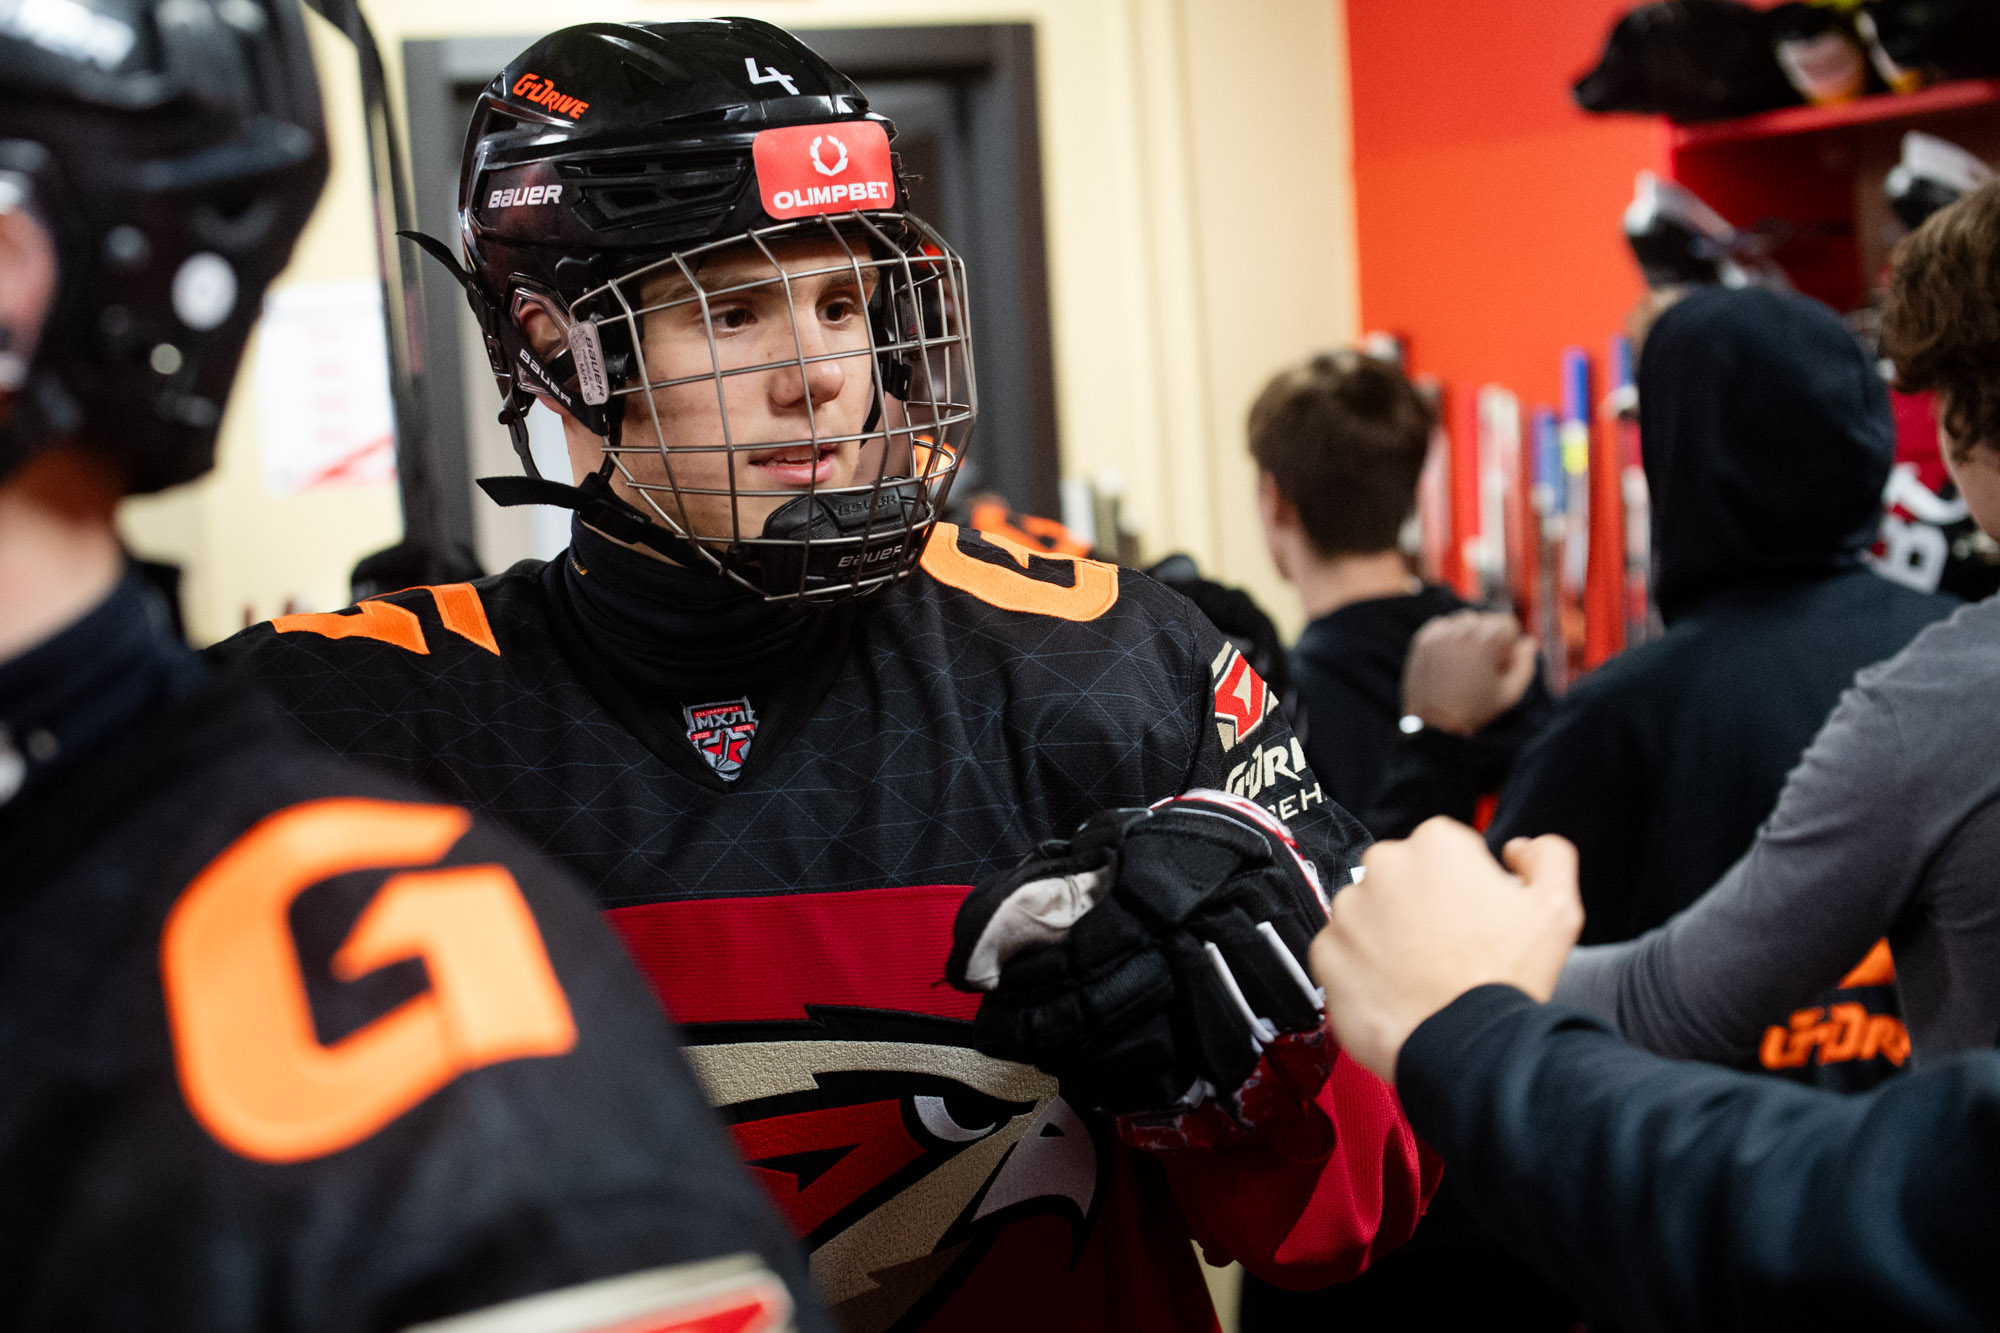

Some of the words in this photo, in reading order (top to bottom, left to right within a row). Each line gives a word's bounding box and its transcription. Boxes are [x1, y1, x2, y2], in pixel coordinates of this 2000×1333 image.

[744, 57, 800, 95] 4
[488, 184, 563, 209] BAUER
[773, 181, 888, 210] OLIMPBET
[519, 348, 572, 407] BAUER
